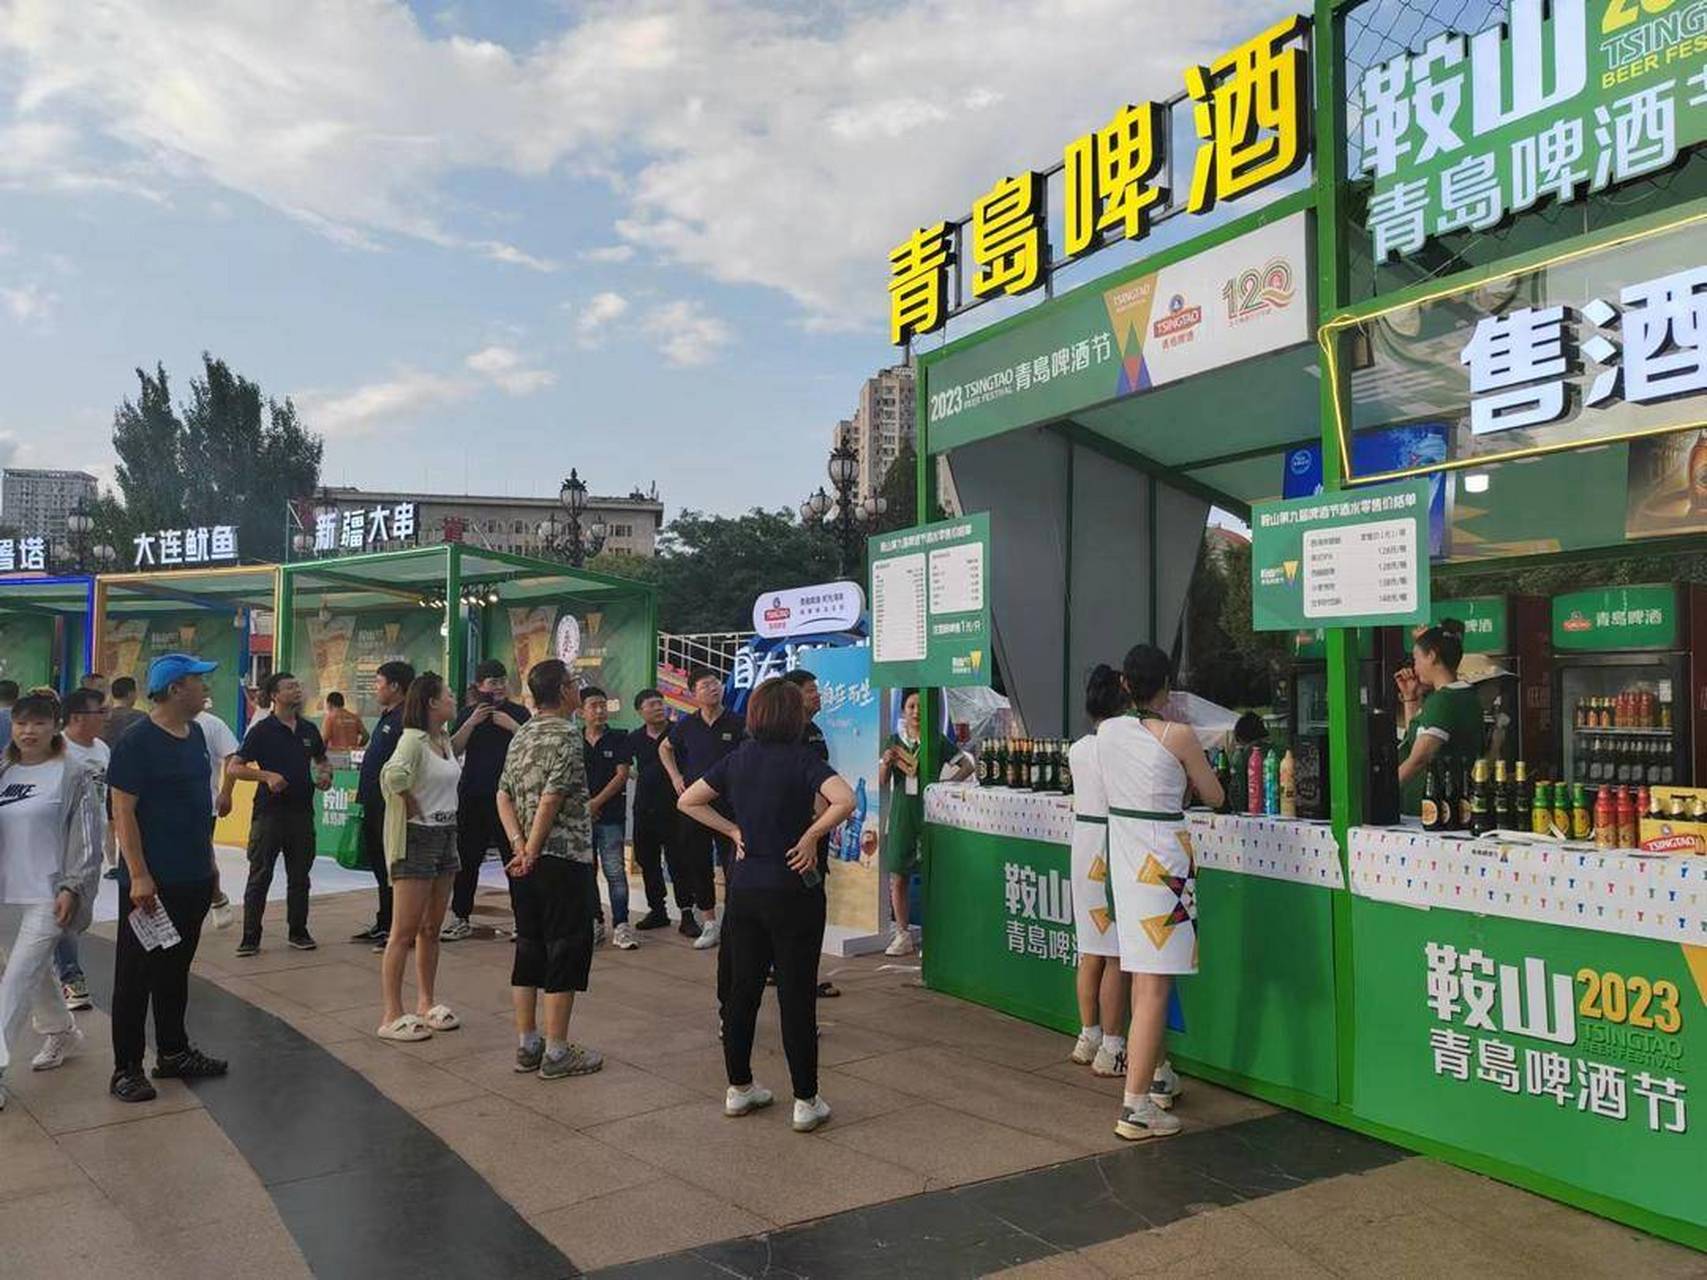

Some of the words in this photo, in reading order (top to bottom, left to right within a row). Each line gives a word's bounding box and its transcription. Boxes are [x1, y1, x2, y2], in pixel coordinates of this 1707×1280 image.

[1361, 0, 1587, 179] 鞍山
[1602, 51, 1660, 89] BEER
[887, 14, 1305, 346] 青岛啤酒
[1155, 308, 1201, 336] TSINGTAO
[1461, 265, 1707, 435] 售酒
[931, 386, 963, 422] 2023
[964, 369, 1013, 398] TSINGTAO
[1015, 333, 1111, 391] 青岛啤酒节
[134, 526, 237, 566] 大连鱿鱼
[313, 502, 414, 554] 新疆大串
[1596, 608, 1662, 627] 青岛啤酒
[1004, 862, 1072, 925] 鞍山
[1425, 942, 1577, 1046] 鞍山
[1577, 968, 1682, 1034] 2023
[1580, 1020, 1684, 1059] TSINGTAO
[1430, 1028, 1688, 1133] 青岛啤酒节
